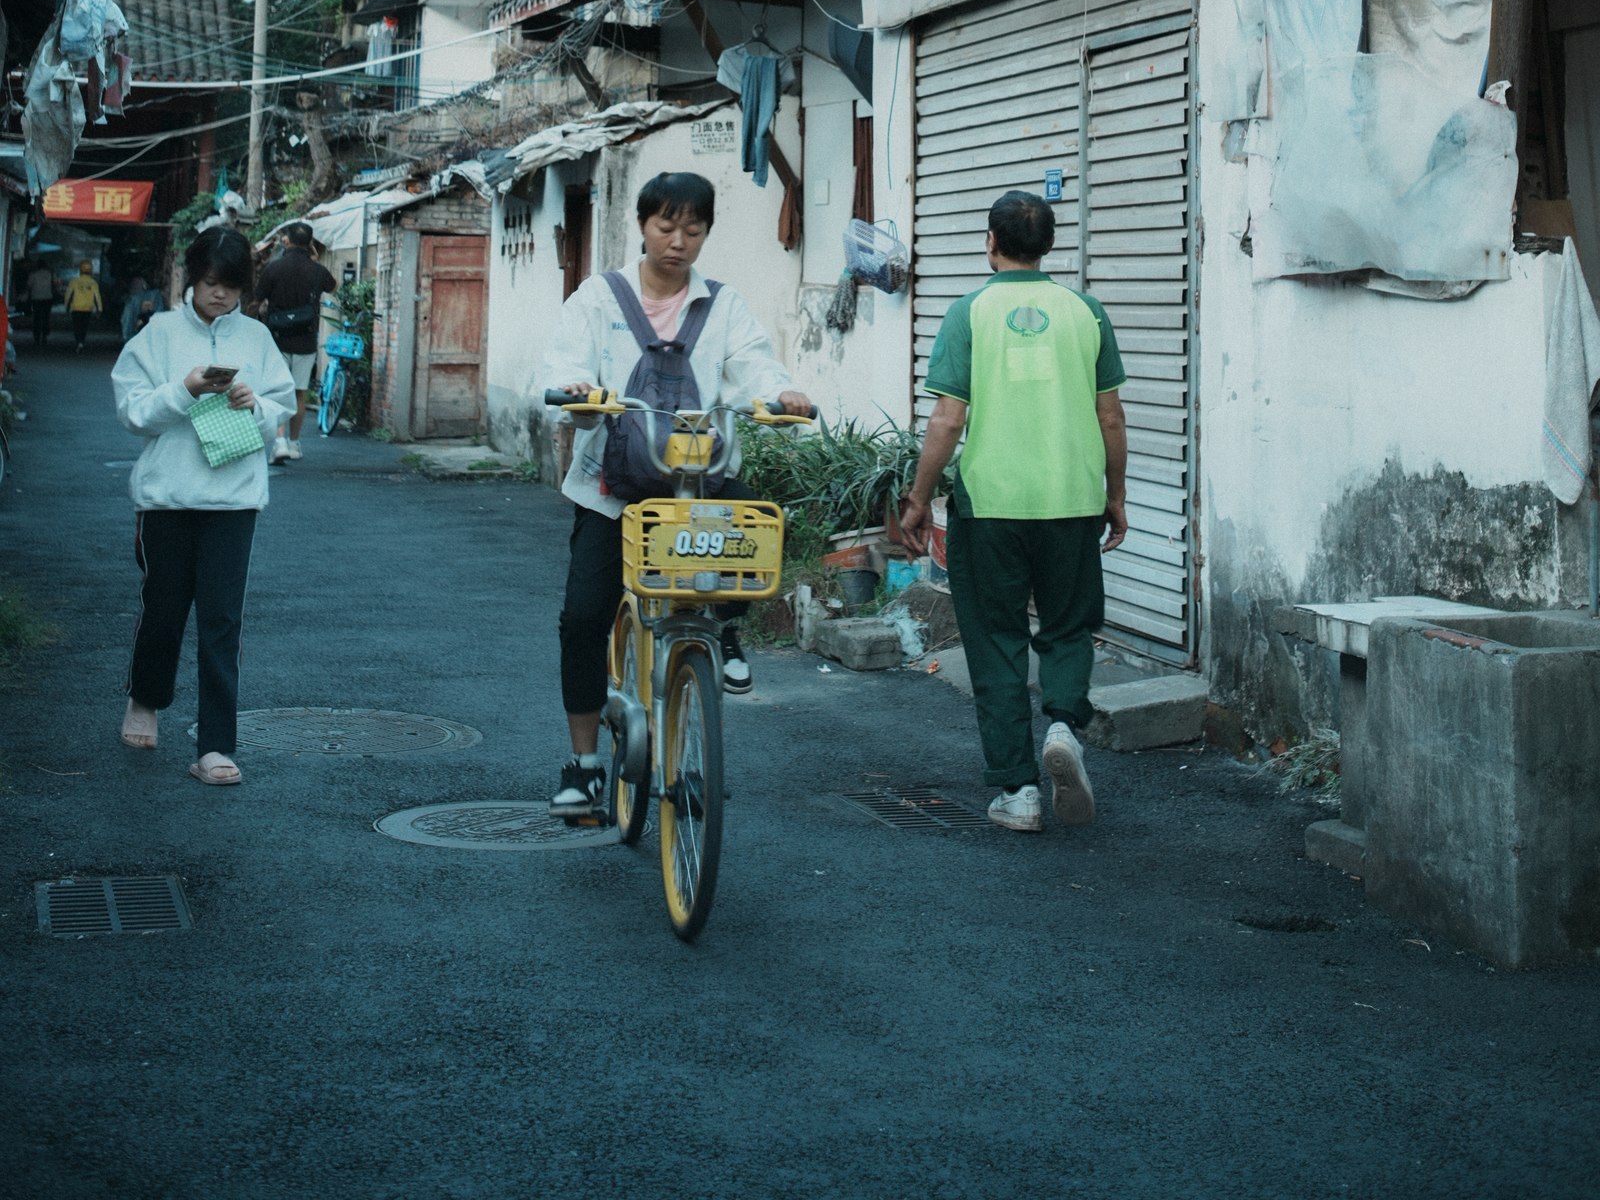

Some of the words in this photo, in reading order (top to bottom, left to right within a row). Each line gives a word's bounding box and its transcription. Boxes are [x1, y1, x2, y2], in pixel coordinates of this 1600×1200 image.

[691, 120, 735, 133] 门面急售
[675, 530, 725, 557] 0.99
